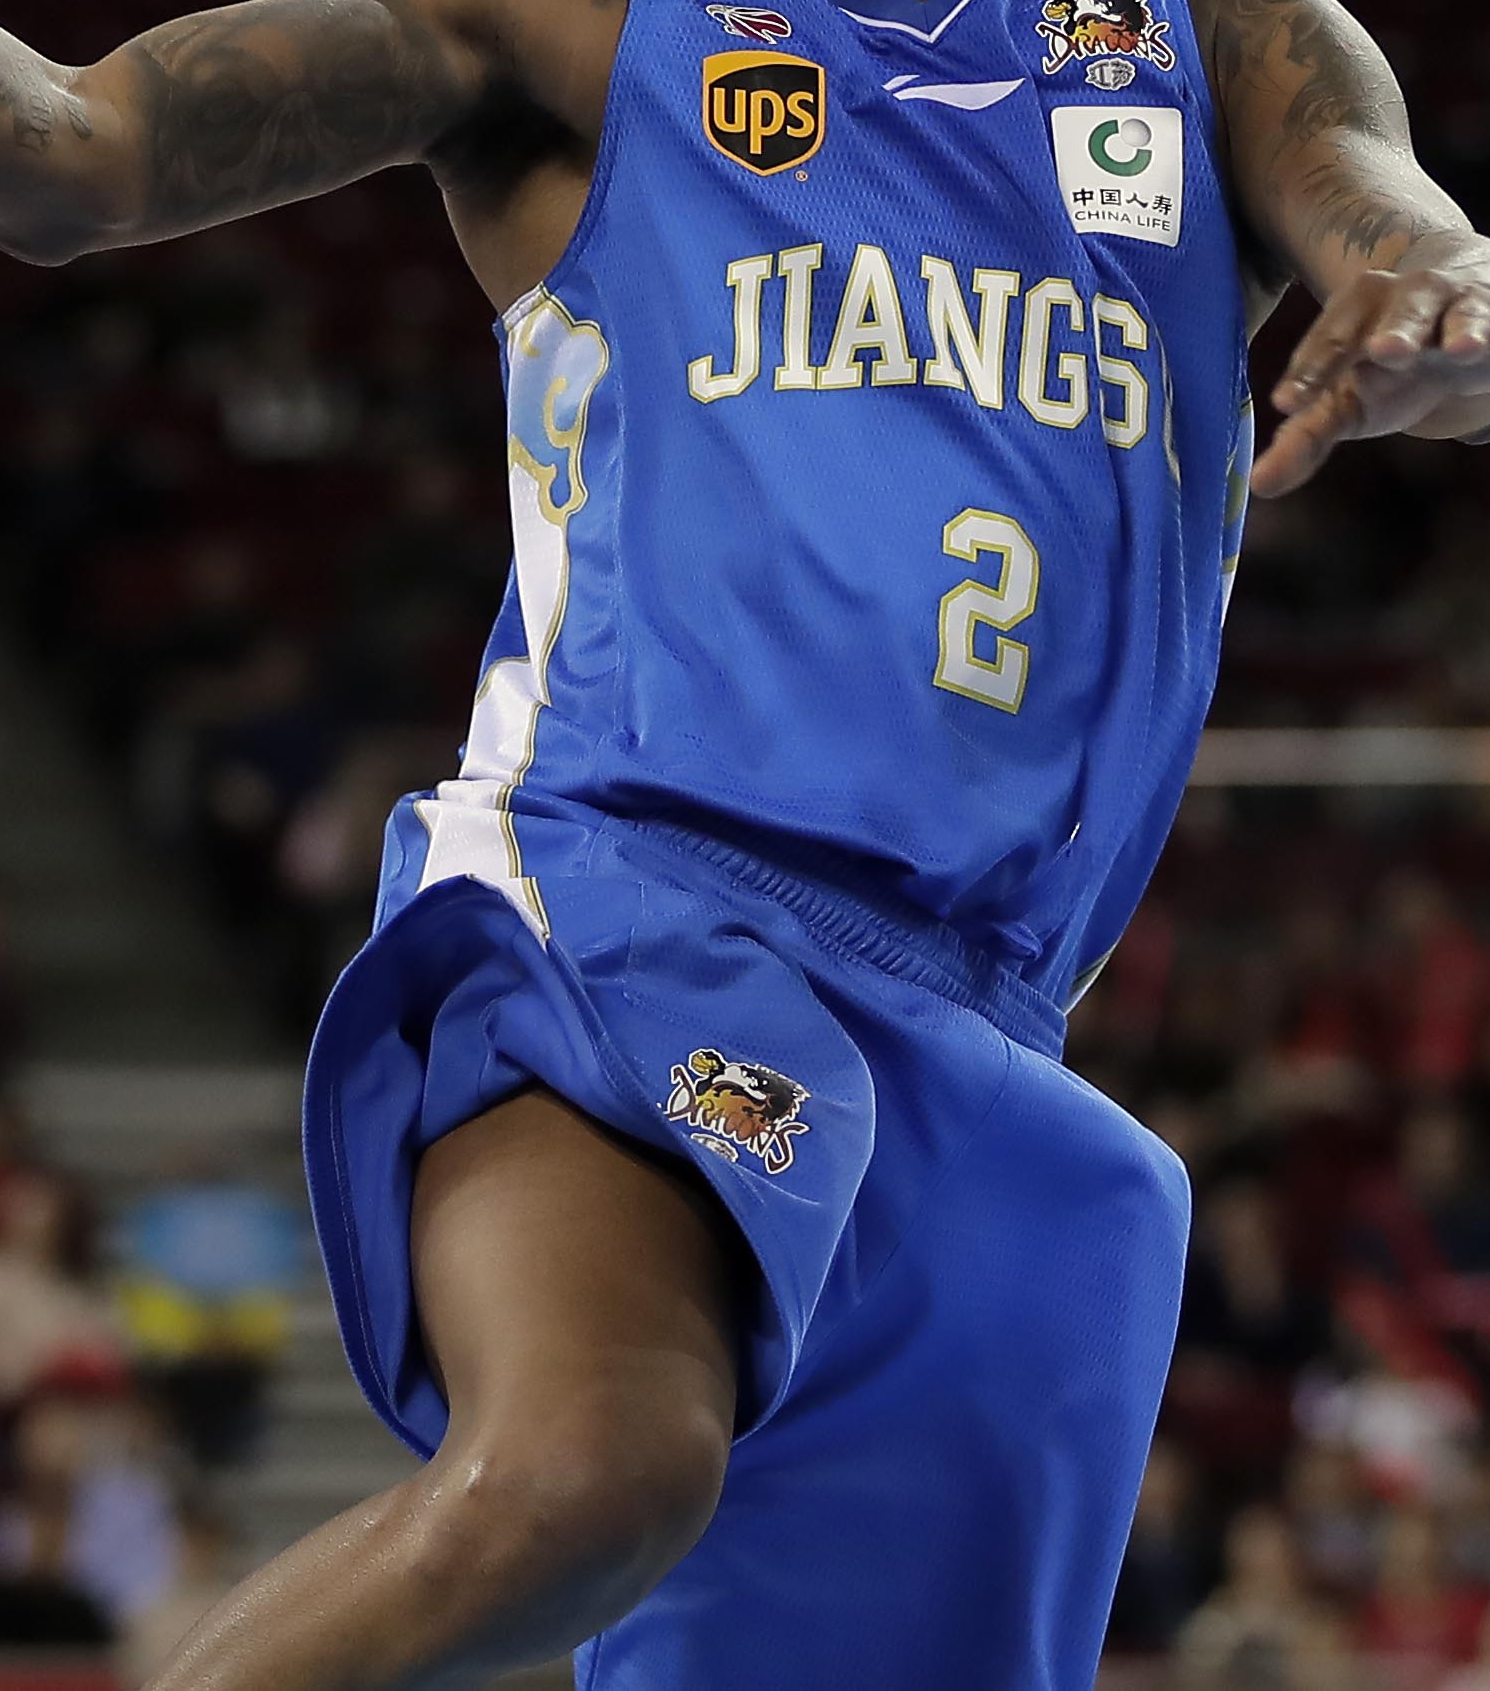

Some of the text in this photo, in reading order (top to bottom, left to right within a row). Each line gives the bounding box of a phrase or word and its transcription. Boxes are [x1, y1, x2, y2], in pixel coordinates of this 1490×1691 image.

[713, 87, 815, 155] ups
[1072, 188, 1173, 216] 中国人寿
[1074, 210, 1171, 232] CHINA LIFE
[688, 243, 1182, 485] JIANGS
[933, 508, 1039, 715] 2
